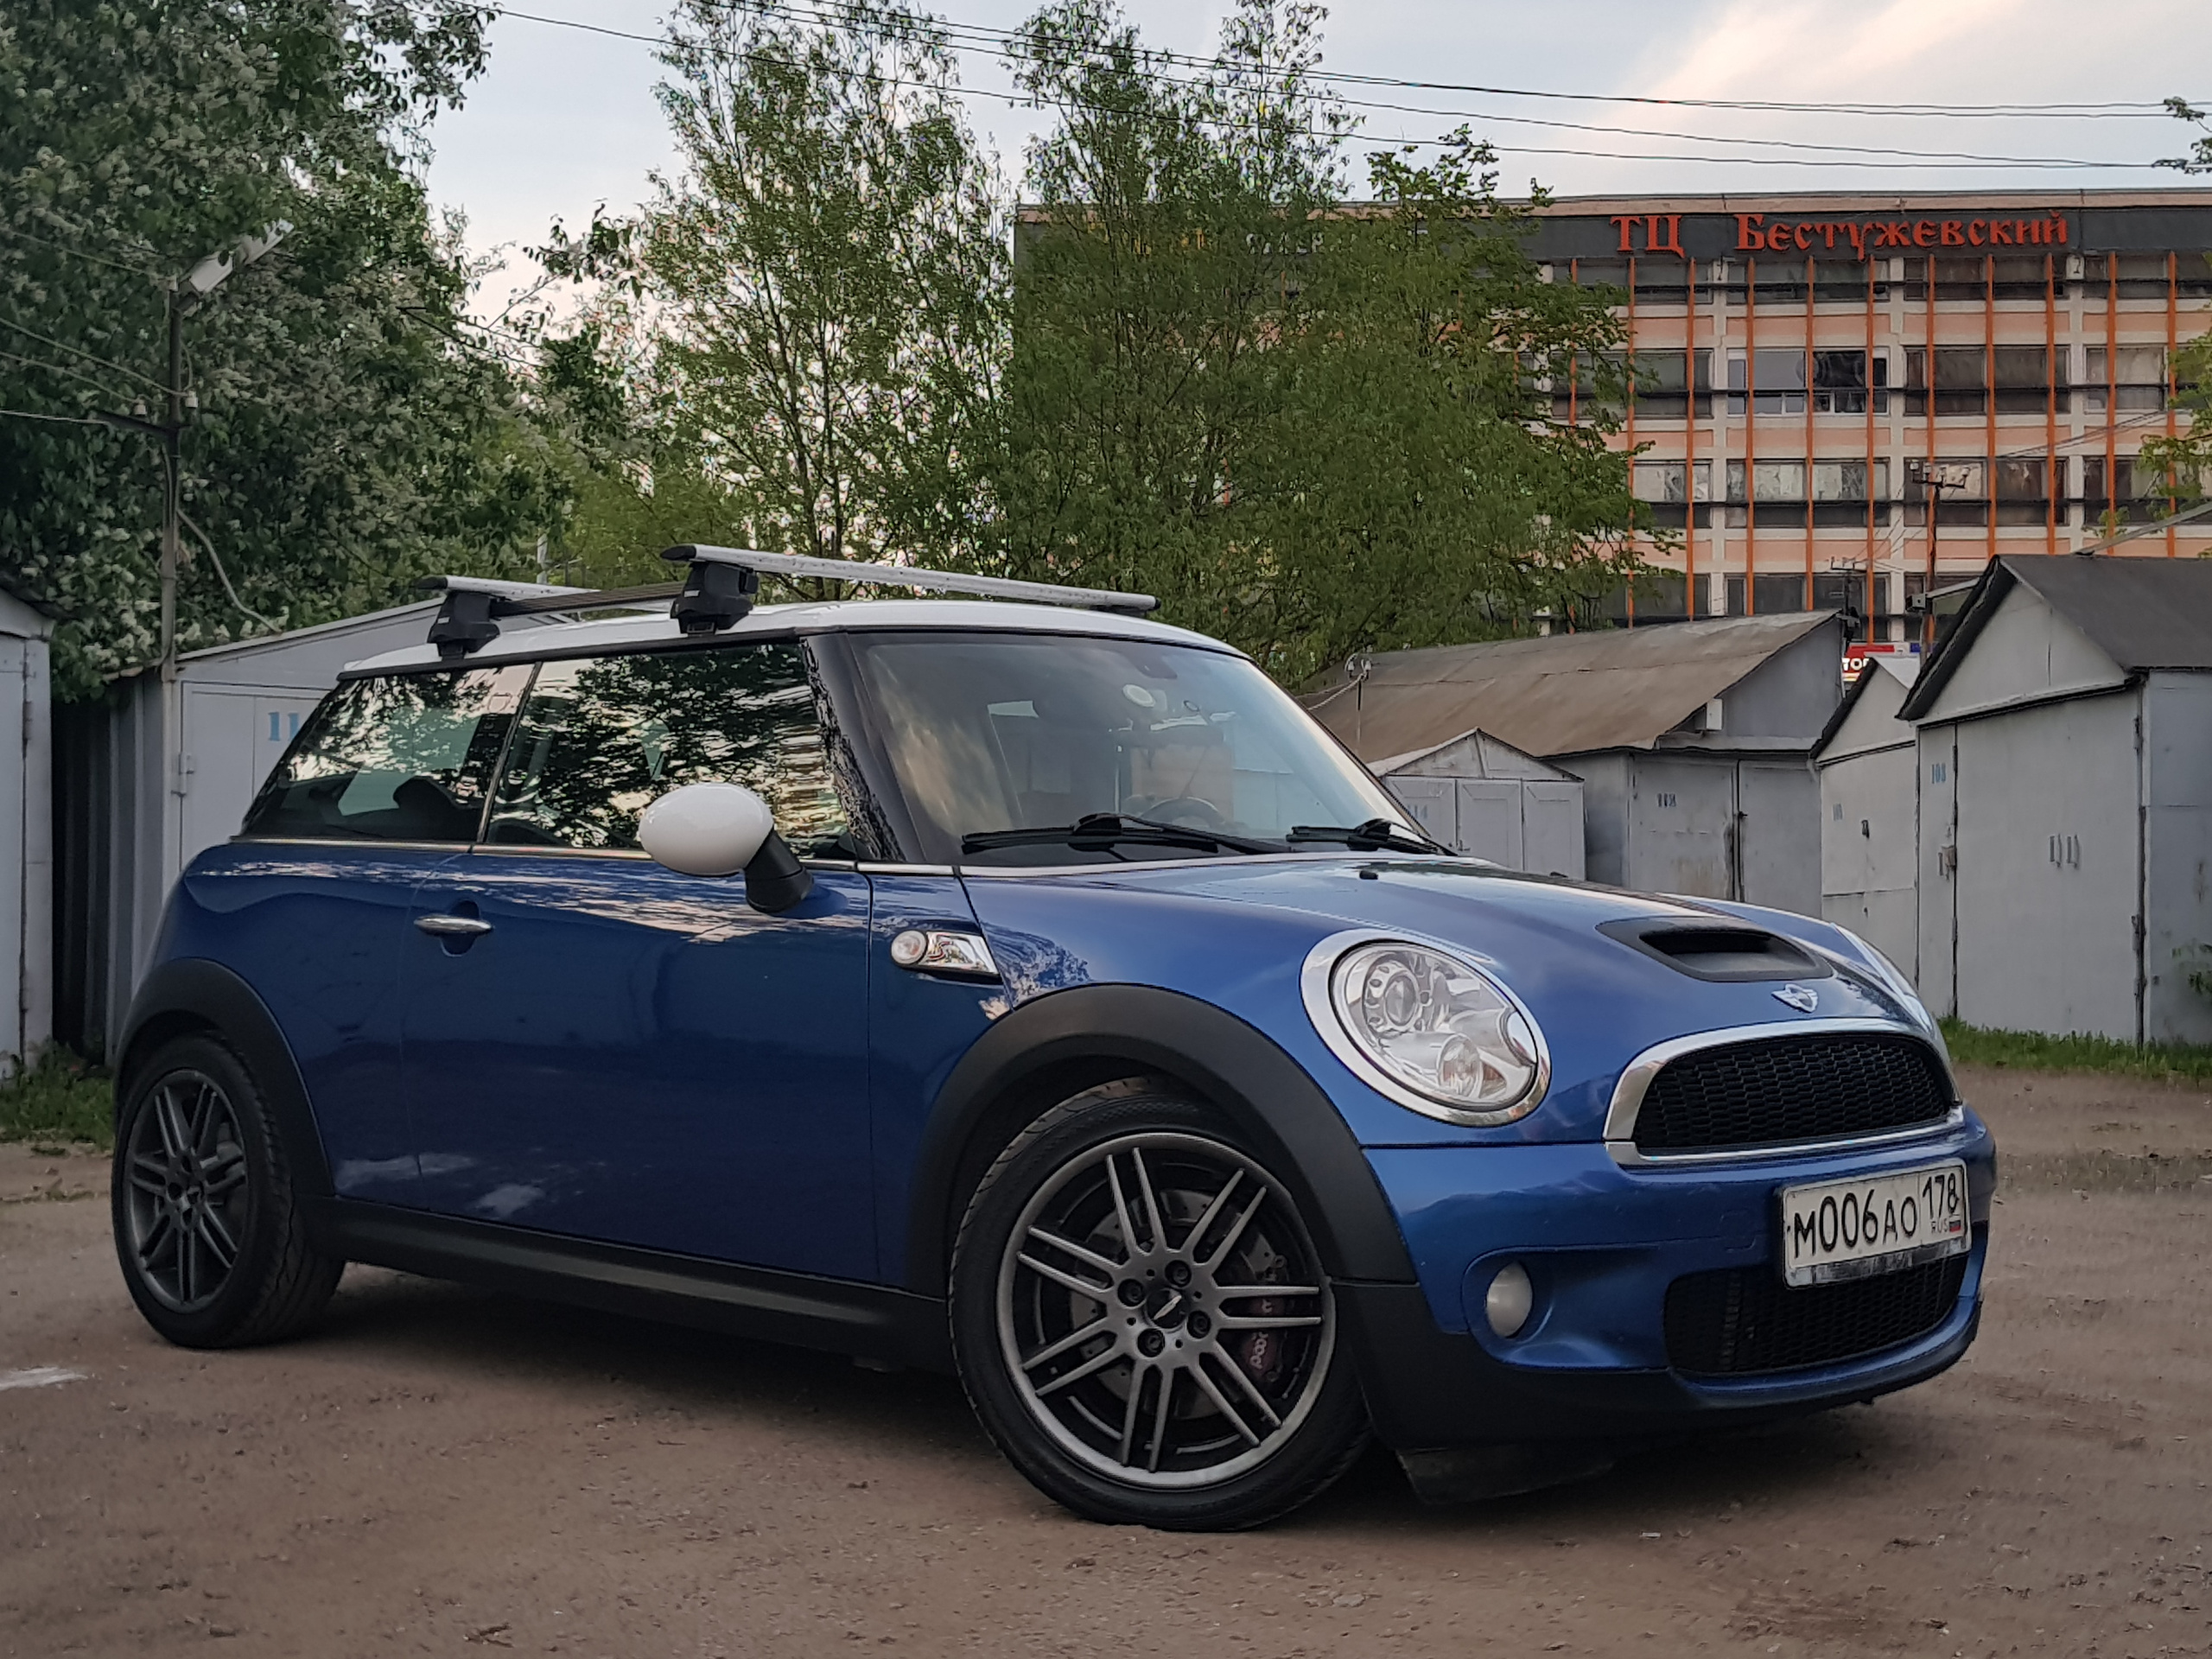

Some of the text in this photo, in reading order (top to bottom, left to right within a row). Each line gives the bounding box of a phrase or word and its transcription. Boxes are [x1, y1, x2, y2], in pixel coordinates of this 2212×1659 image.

[1610, 209, 2069, 261] ТЦ Бестужевский
[1922, 1172, 1960, 1219] 178
[1930, 1217, 1949, 1234] RUS
